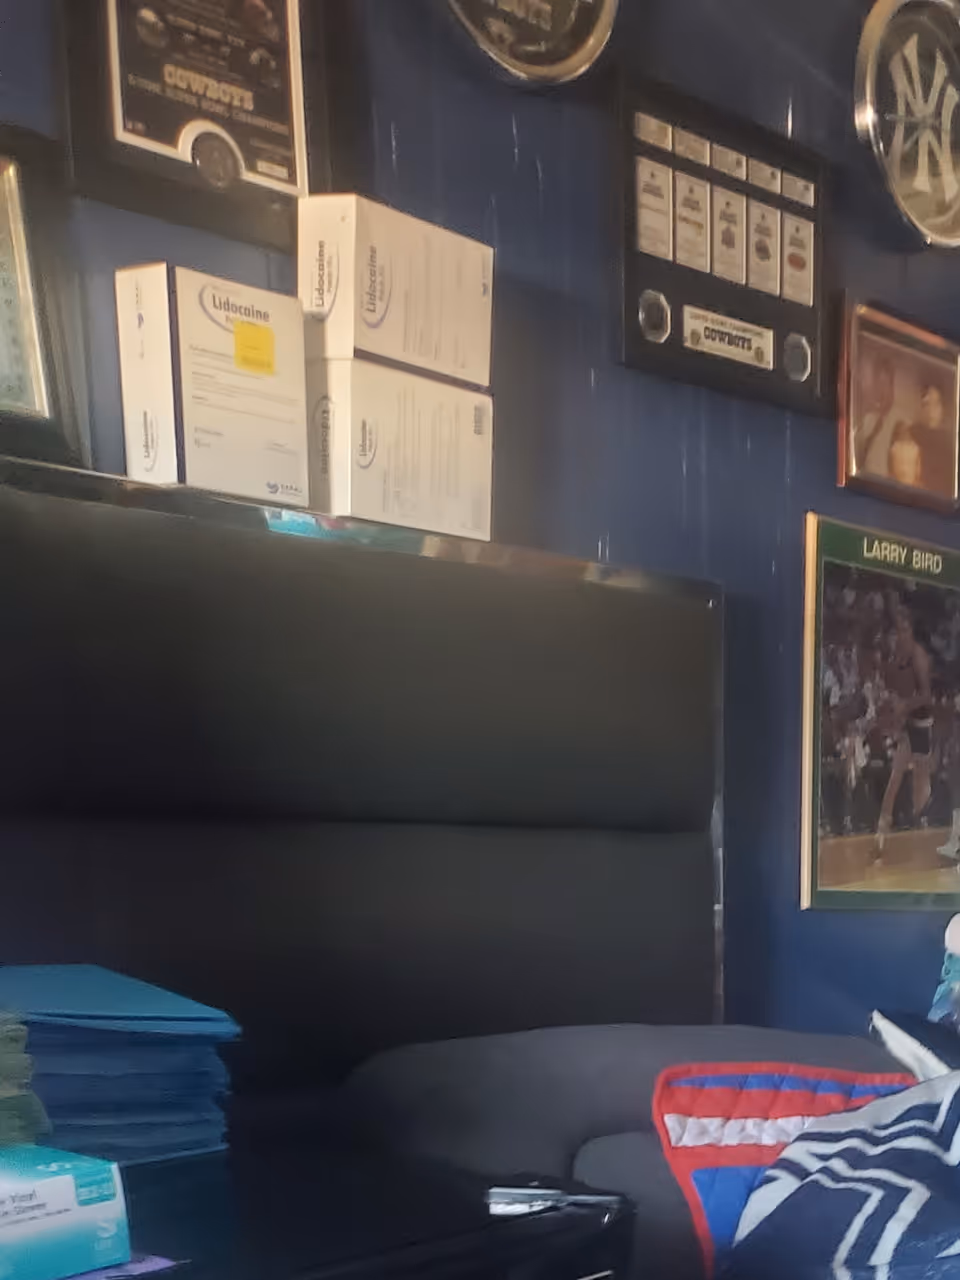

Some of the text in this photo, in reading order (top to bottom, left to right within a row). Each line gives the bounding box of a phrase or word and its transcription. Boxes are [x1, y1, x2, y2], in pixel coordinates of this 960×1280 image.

[163, 63, 254, 111] COWBOYS
[314, 239, 326, 308] Lidocaine
[364, 244, 377, 314] Lidocaine
[211, 292, 271, 323] Lidocaine
[703, 325, 753, 352] COWBOYS
[863, 536, 943, 575] LARRY BIRD
